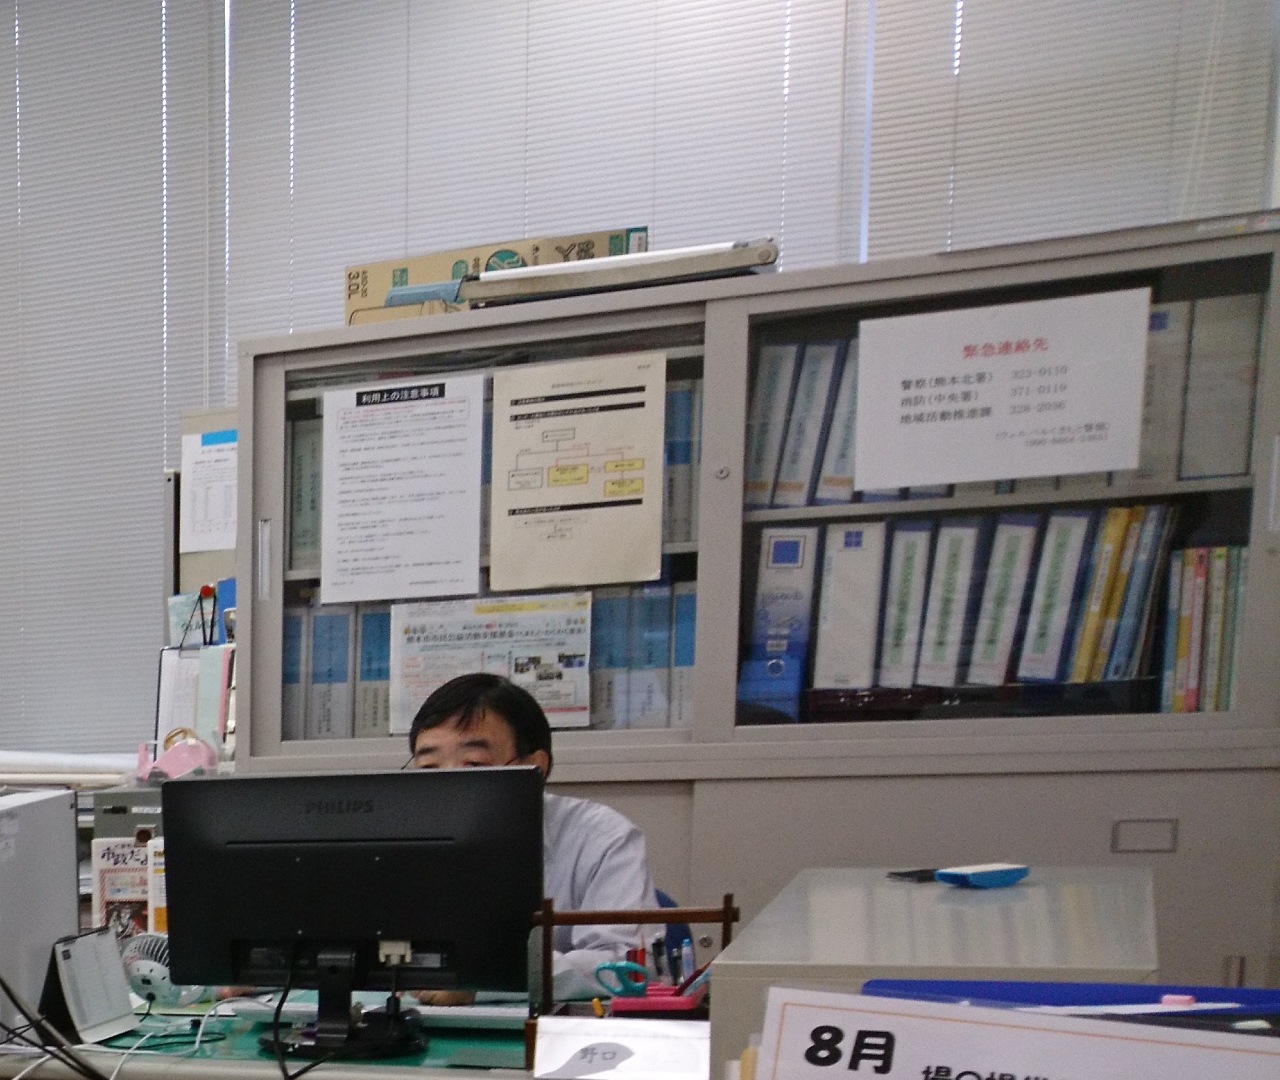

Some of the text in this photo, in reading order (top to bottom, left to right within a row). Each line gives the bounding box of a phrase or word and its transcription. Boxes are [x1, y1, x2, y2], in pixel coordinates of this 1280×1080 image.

[962, 337, 1049, 359] 緊急連絡先
[360, 386, 441, 406] 利用上の注意事項
[579, 1046, 617, 1064] 野口
[803, 1025, 897, 1075] 8月
